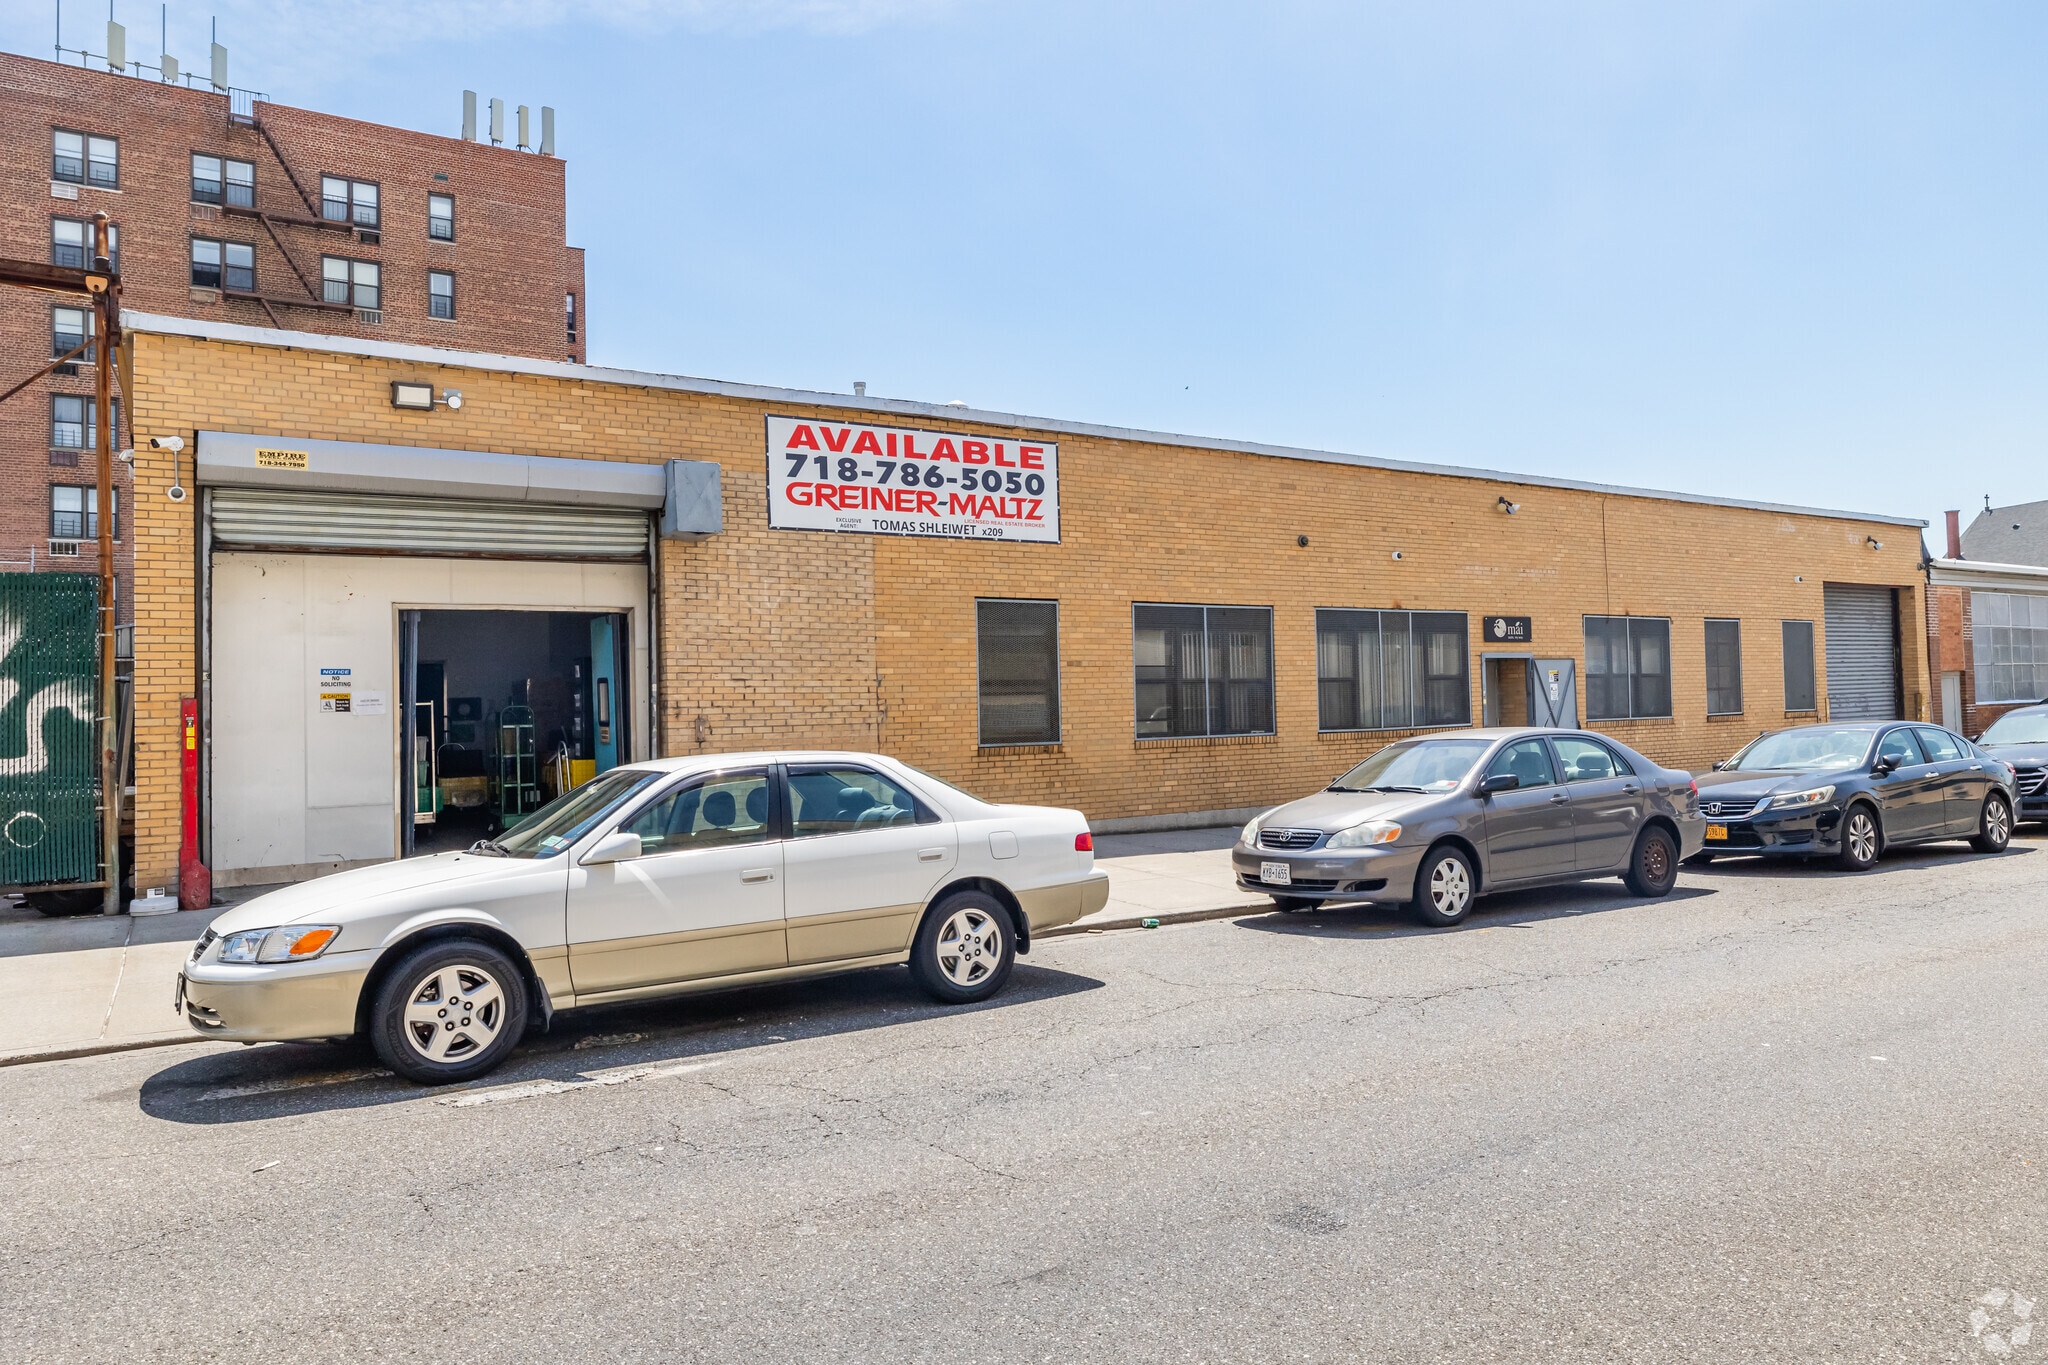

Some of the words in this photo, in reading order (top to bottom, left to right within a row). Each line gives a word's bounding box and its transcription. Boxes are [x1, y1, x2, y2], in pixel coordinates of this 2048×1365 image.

[259, 451, 306, 459] EMPIRE
[786, 424, 1044, 470] AVAILABLE
[786, 453, 1045, 496] 718-786-5050
[786, 482, 1045, 520] GREINER-MALTZ
[872, 520, 916, 532] TOMAS
[919, 522, 976, 535] SHLEIWET
[982, 528, 1003, 537] x209
